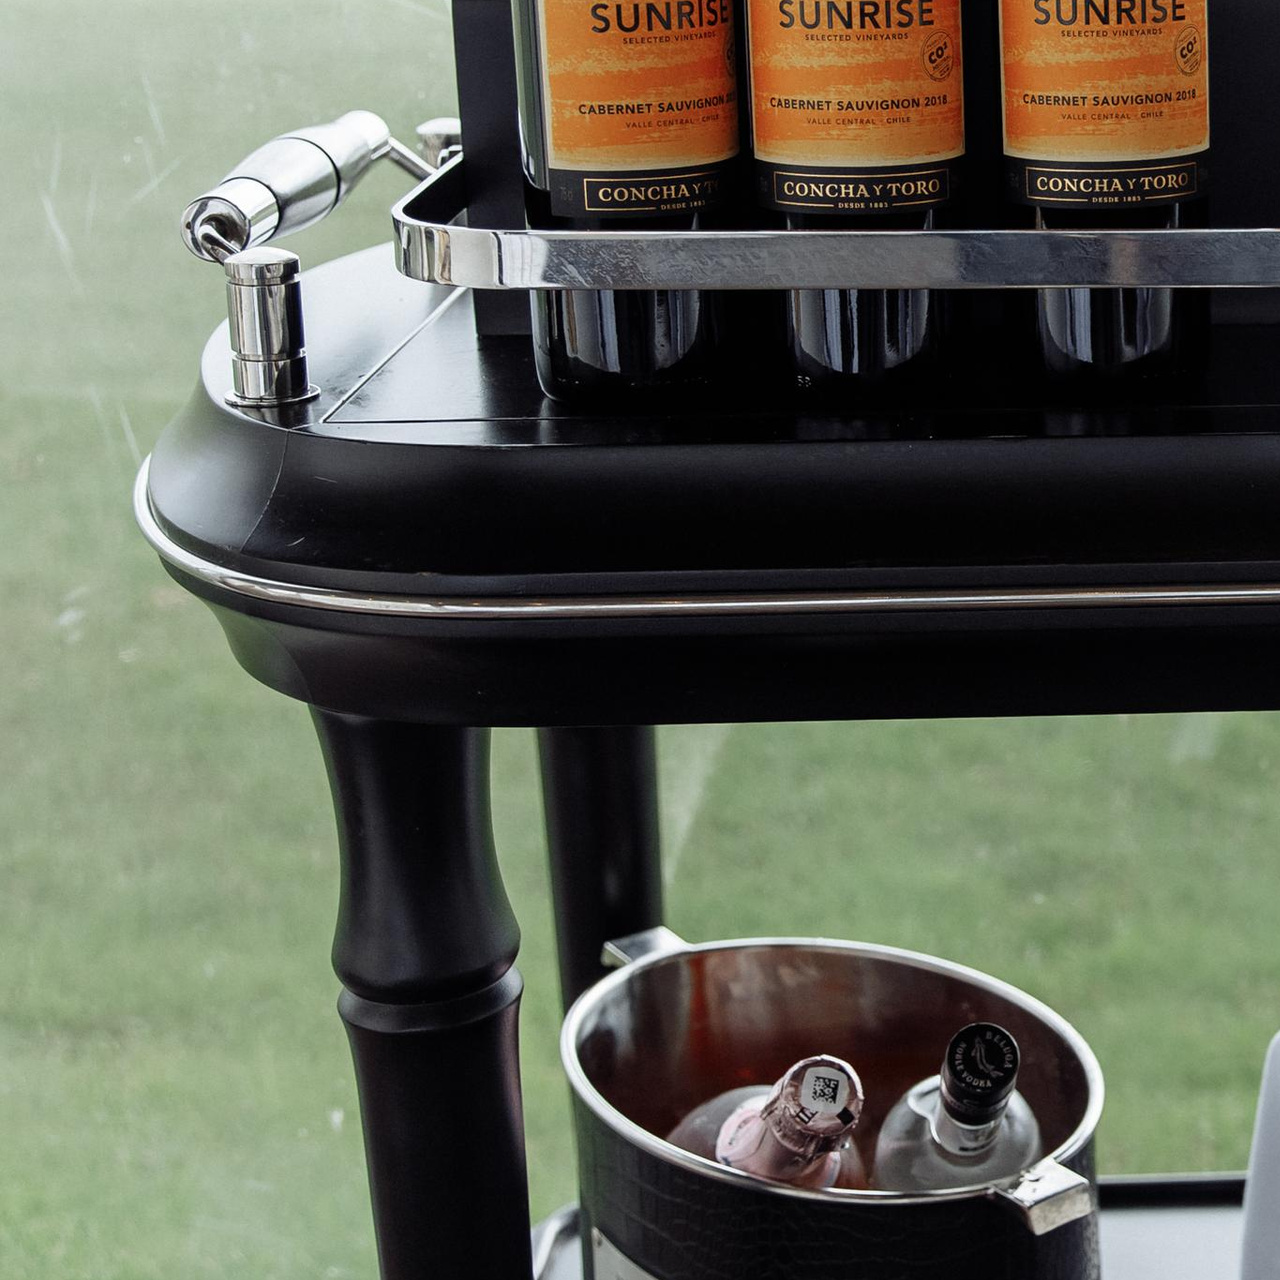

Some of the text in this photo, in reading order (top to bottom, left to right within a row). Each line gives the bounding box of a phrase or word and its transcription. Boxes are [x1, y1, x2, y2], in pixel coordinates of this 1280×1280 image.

[623, 32, 717, 44] SELECTED VINEYARDS
[805, 33, 908, 41] SELECTED VINEYARDS
[1061, 28, 1162, 38] SELECTED VINEYARDS
[578, 104, 652, 115] CABERNET
[658, 95, 724, 113] SAUVIGNON
[770, 95, 948, 111] CABERNET SAUVIGNON 2018
[1023, 89, 1196, 106] CABERNET SAUVIGNON 2018
[625, 117, 694, 129] VALLE CENTRAL
[807, 117, 831, 125] VALLE
[1141, 111, 1163, 119] CHILE
[784, 179, 940, 198] CONCHA Y TORO
[1037, 172, 1188, 193] CONCHA Y TORO
[598, 184, 689, 202] CONCHA
[692, 183, 702, 197] Y
[962, 1071, 992, 1087] VODKA
